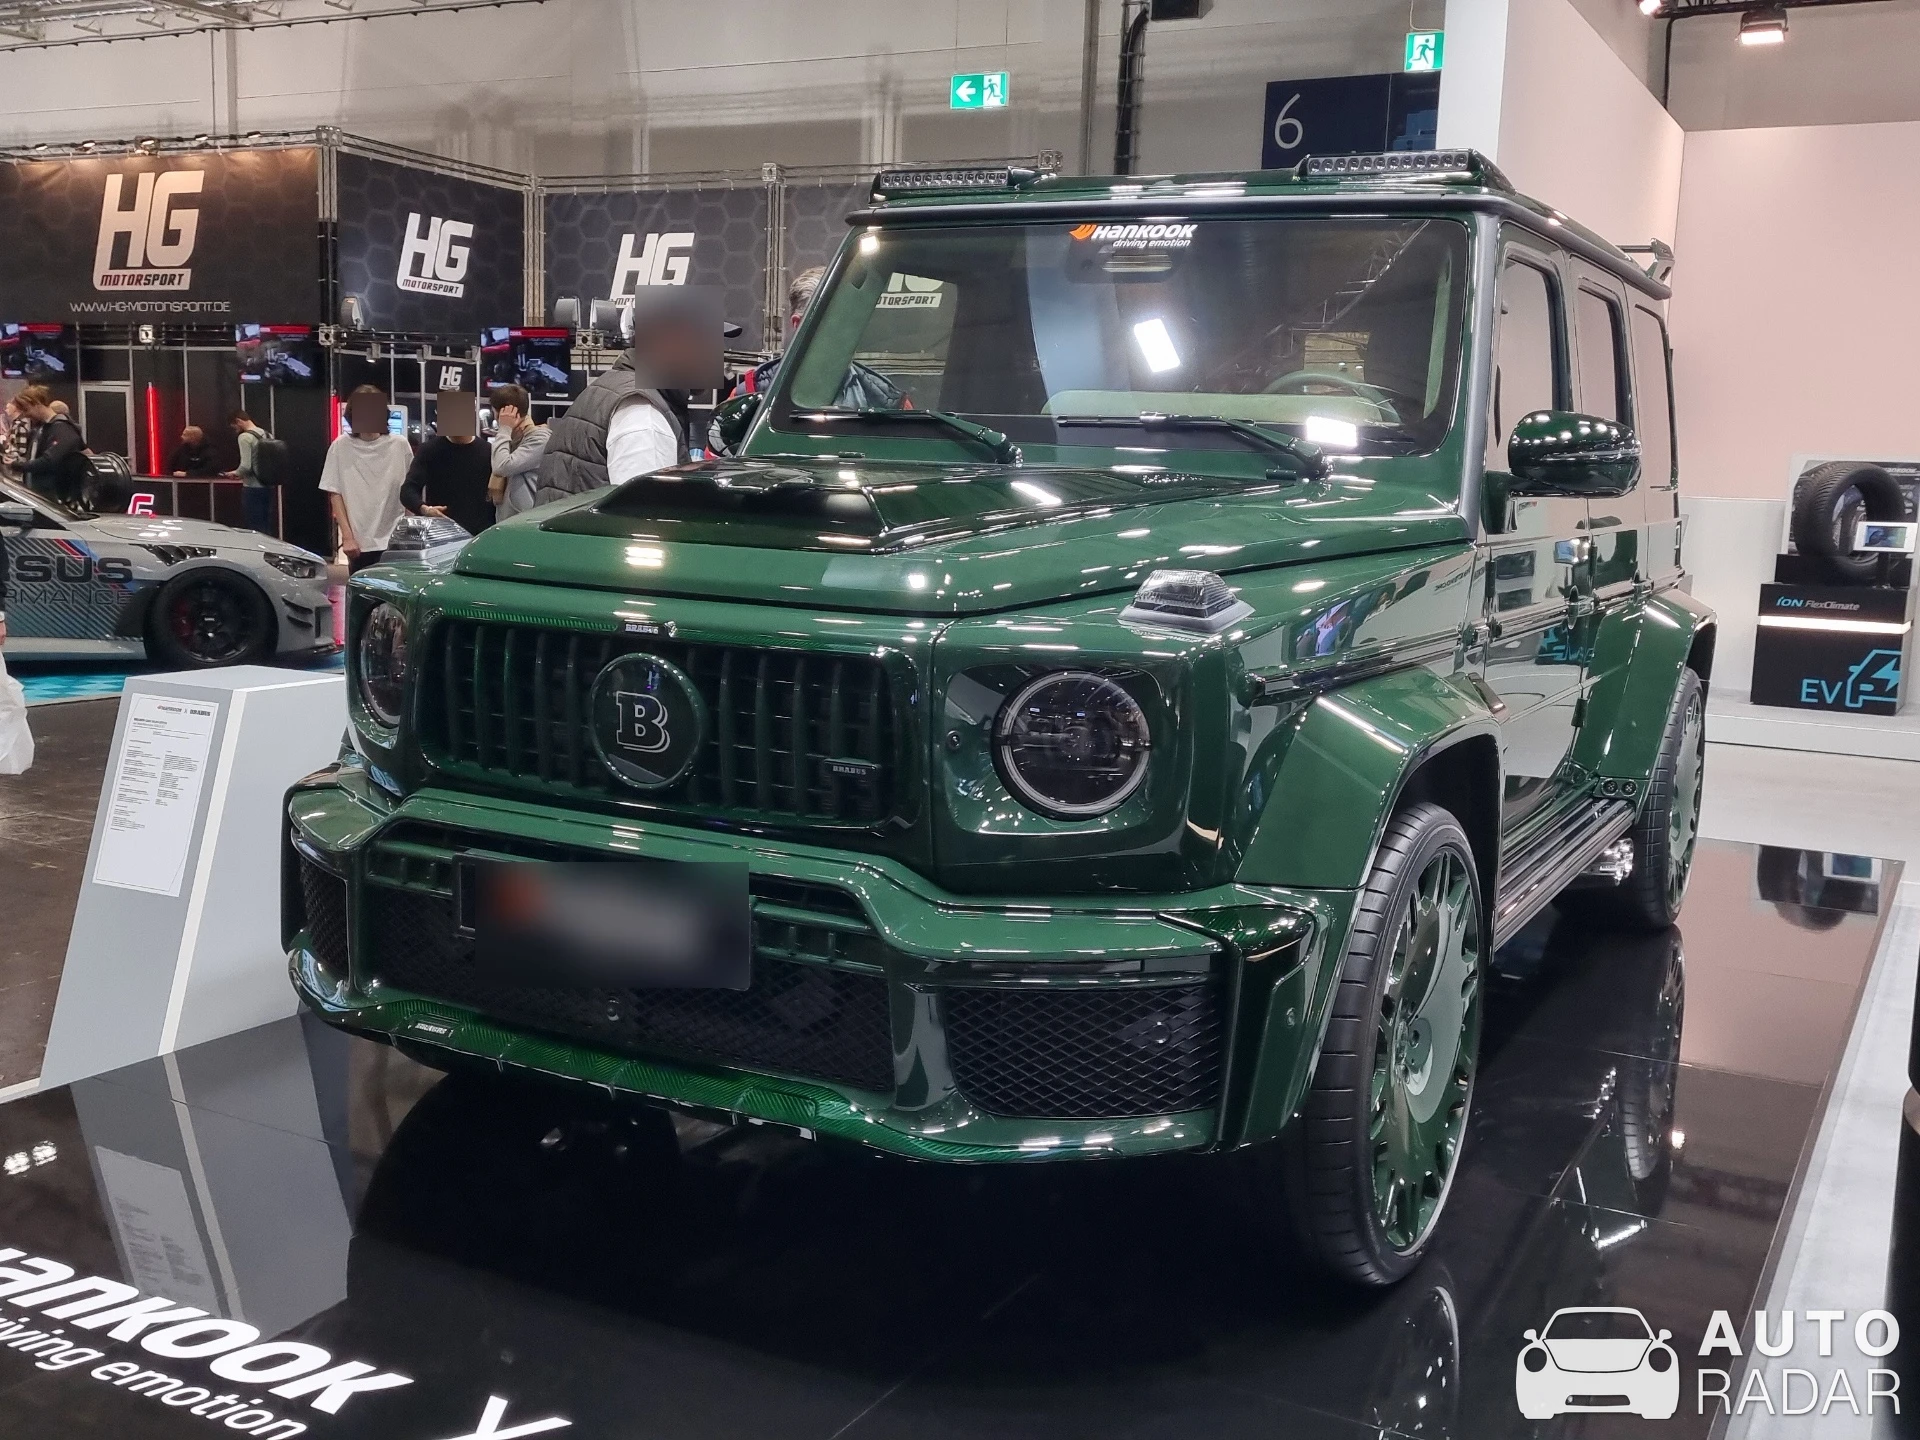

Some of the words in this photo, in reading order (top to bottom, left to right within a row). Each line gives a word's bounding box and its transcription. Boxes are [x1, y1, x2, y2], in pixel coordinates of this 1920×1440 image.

[1273, 93, 1303, 150] 6
[95, 170, 205, 270] HG
[398, 212, 474, 282] HG
[1113, 239, 1147, 249] driving
[1148, 239, 1191, 248] emotion
[100, 273, 184, 286] MOTORSPORT
[402, 278, 460, 294] MOTORSPORT
[440, 365, 463, 388] HG
[1804, 600, 1860, 611] FlexClimate
[1801, 678, 1843, 704] EV
[615, 690, 671, 754] B
[90, 1361, 308, 1440] emotion
